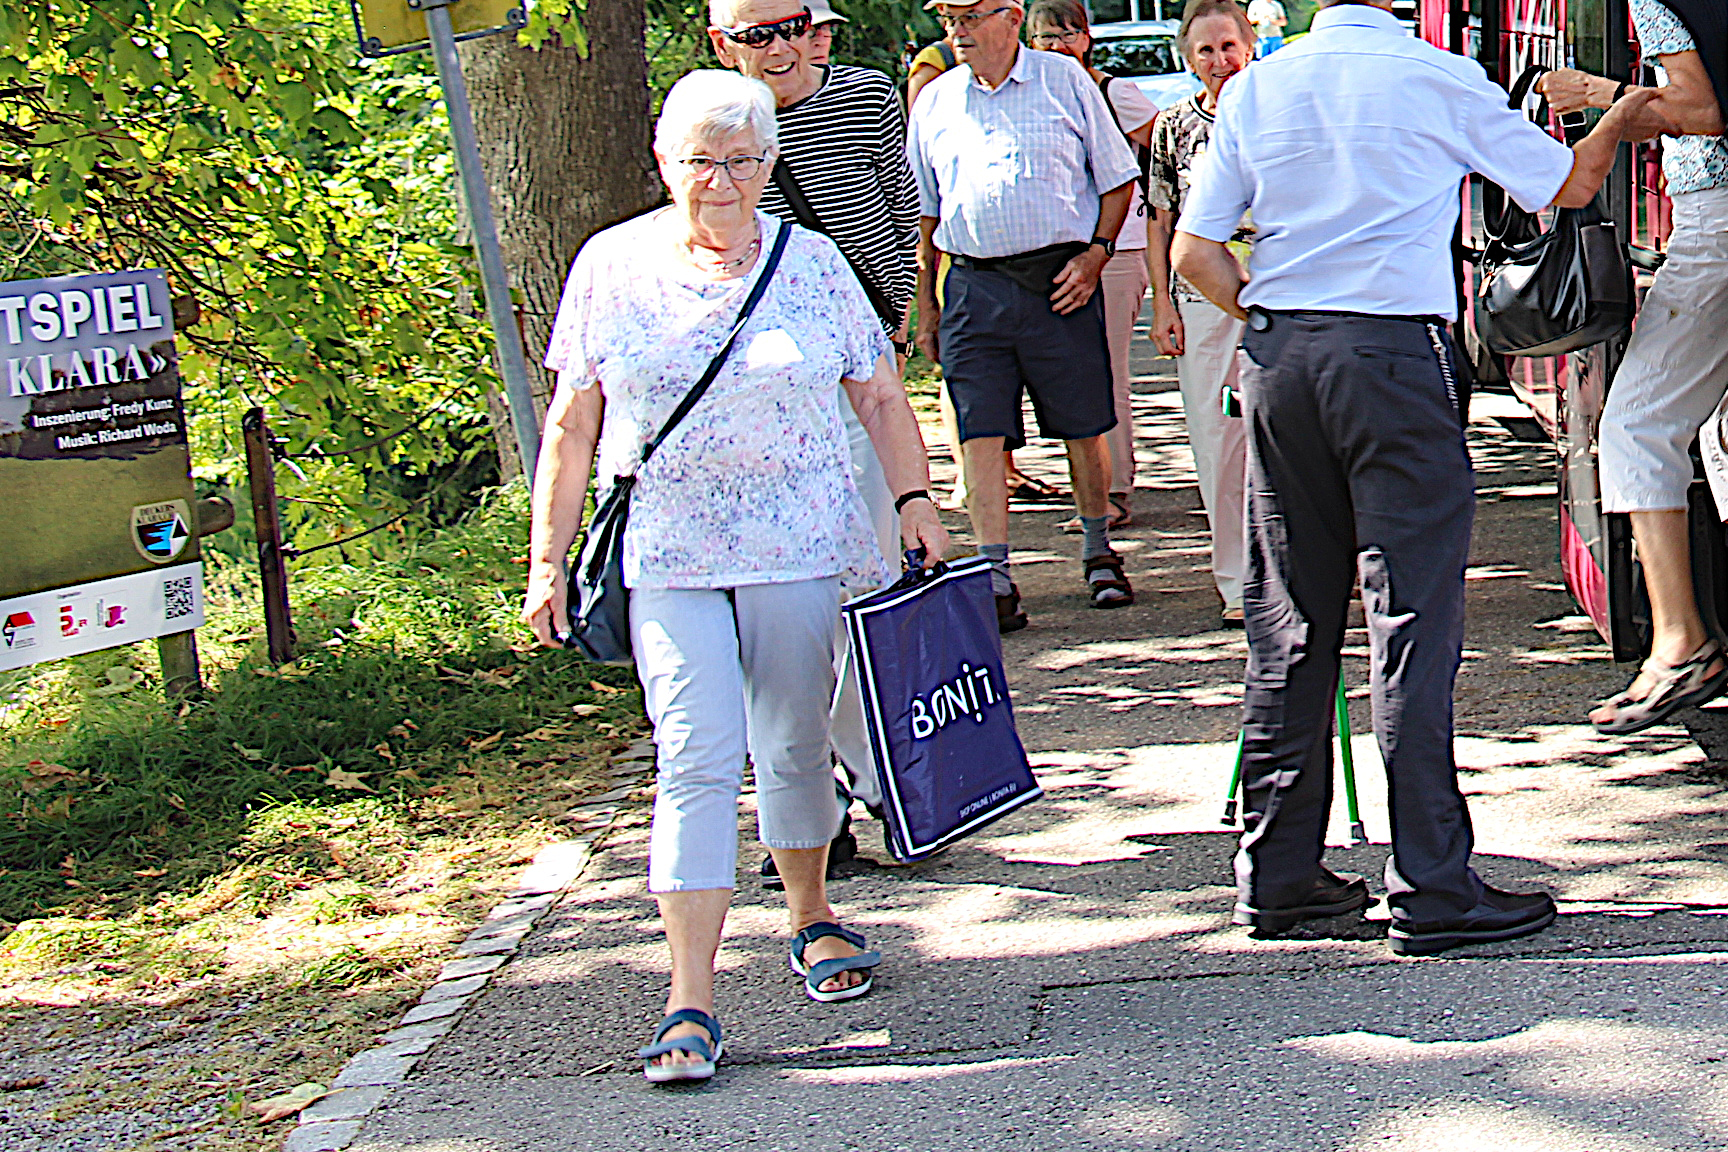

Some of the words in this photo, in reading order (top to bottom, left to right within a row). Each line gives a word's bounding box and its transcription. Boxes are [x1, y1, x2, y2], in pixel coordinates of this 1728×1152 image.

[0, 283, 163, 345] TSPIEL
[33, 406, 112, 428] Inszenierung:
[111, 401, 144, 418] Fredy
[144, 398, 175, 412] Kunz
[58, 433, 99, 450] Musik:
[98, 425, 143, 445] Richard
[143, 420, 178, 436] Woda
[911, 663, 1002, 740] BONIT
